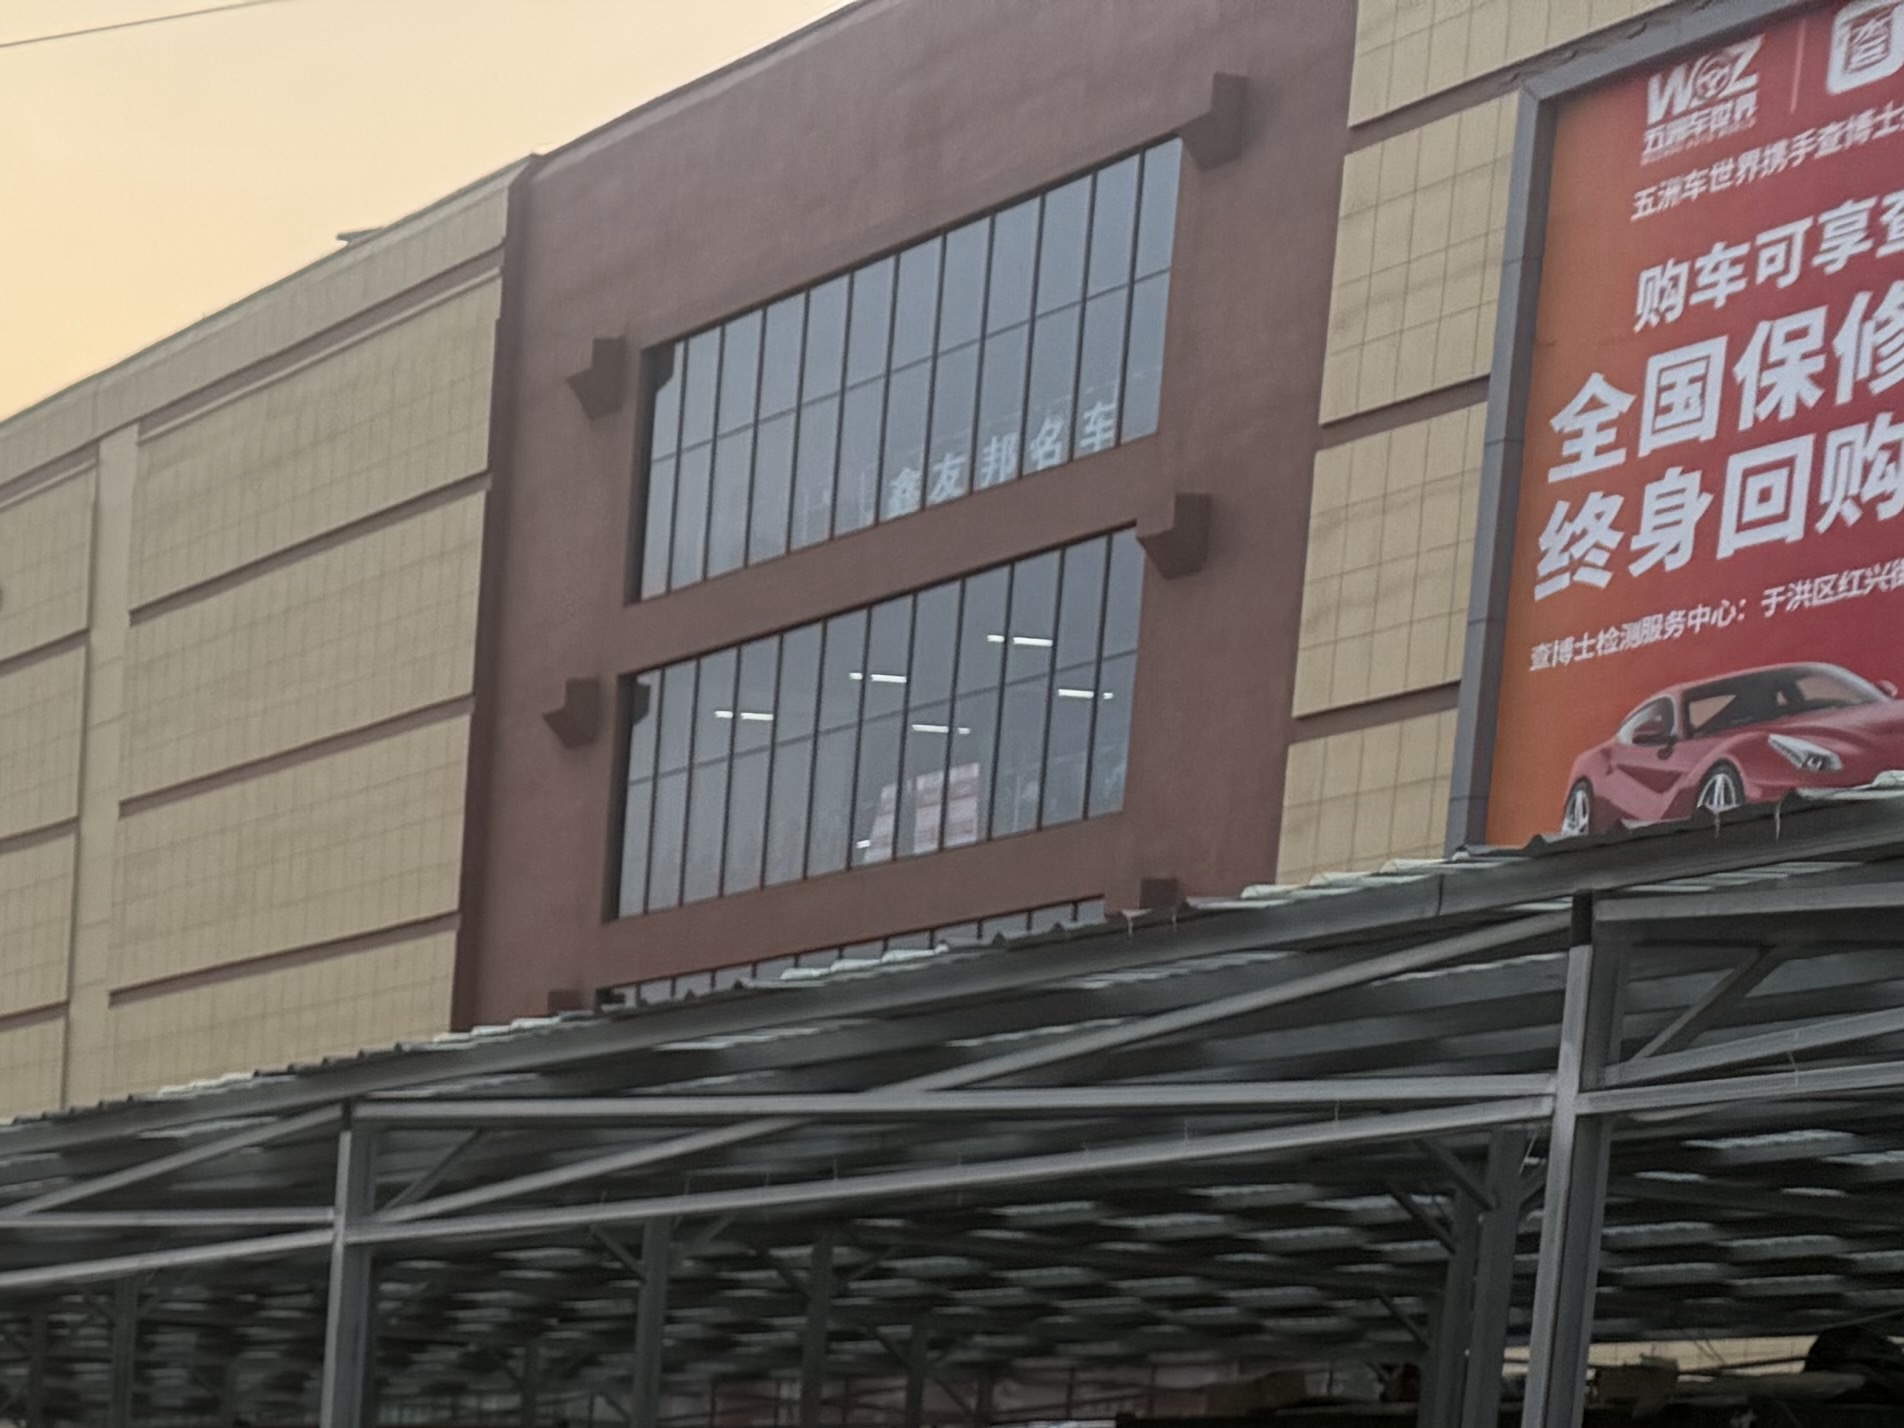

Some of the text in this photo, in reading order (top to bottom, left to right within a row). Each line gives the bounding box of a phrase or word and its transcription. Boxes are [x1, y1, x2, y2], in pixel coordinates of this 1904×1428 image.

[1630, 98, 1904, 222] 五洲车世界携手查博士
[1547, 279, 1904, 485] 全国保修
[1534, 411, 1904, 602] 终身回购
